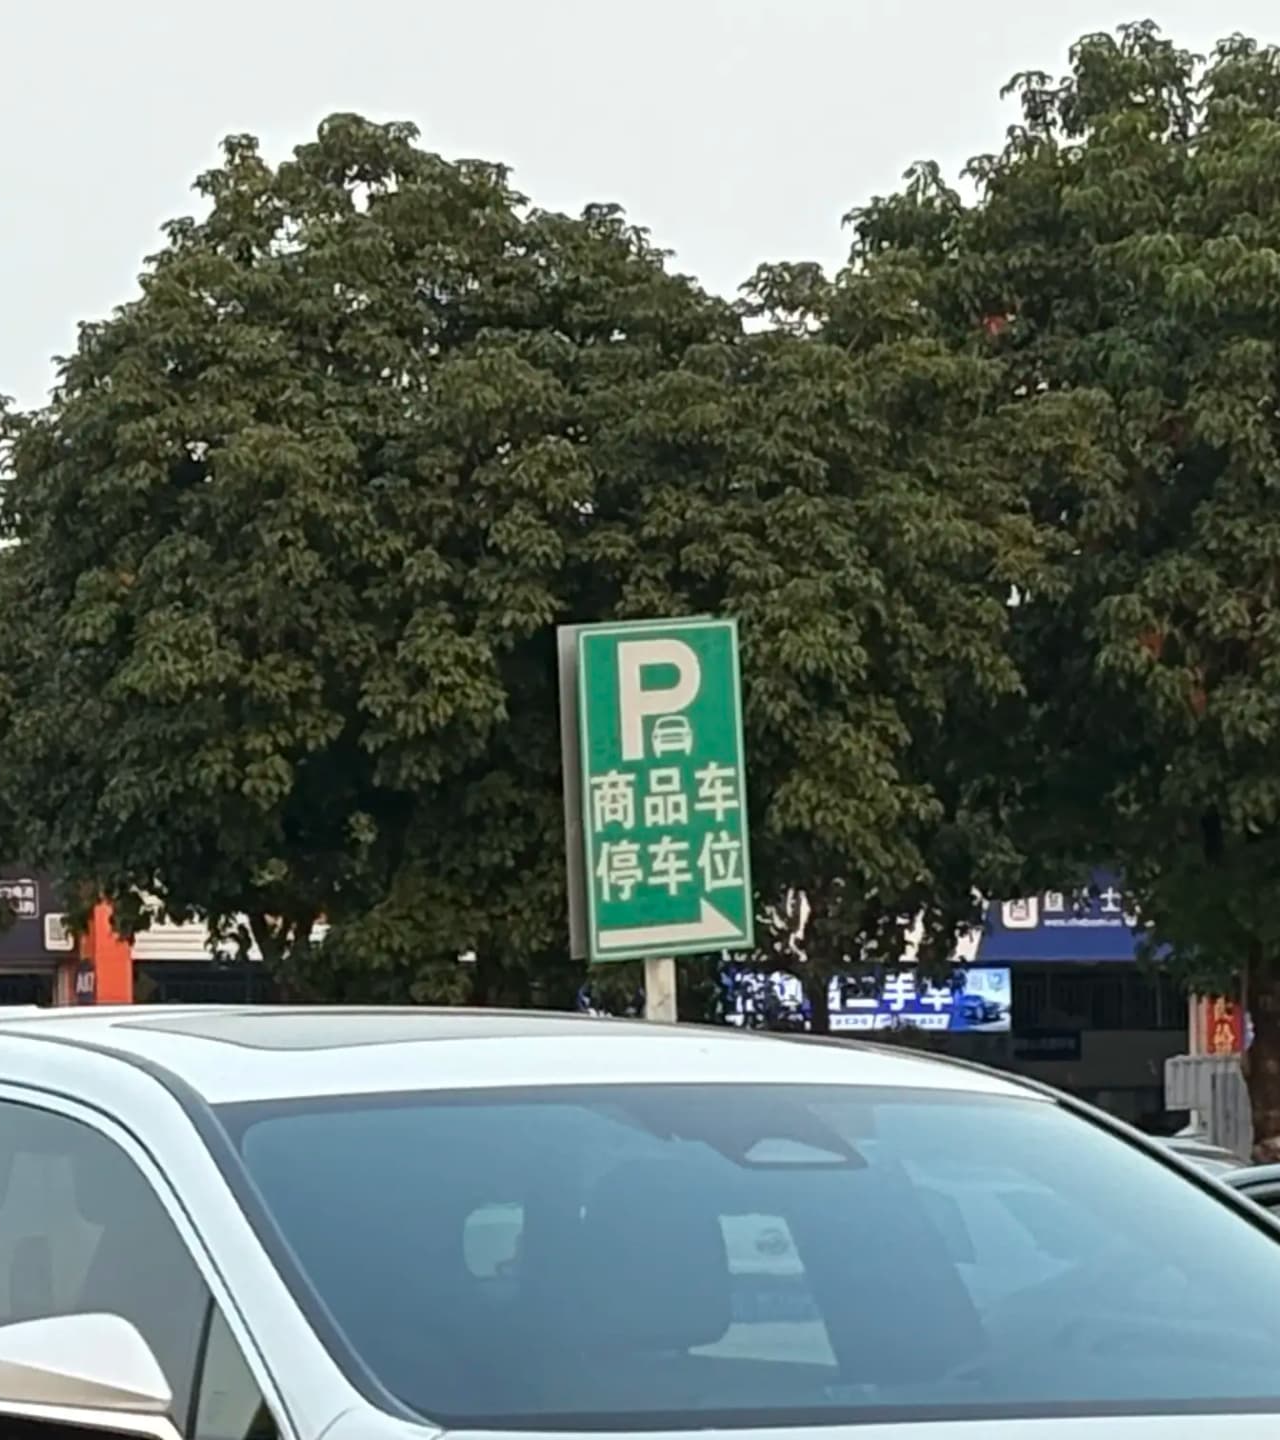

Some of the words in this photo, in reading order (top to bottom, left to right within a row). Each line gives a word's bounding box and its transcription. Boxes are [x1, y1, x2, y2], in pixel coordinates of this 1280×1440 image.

[617, 639, 701, 761] P
[590, 762, 739, 833] 商品车
[596, 830, 744, 902] 停车位
